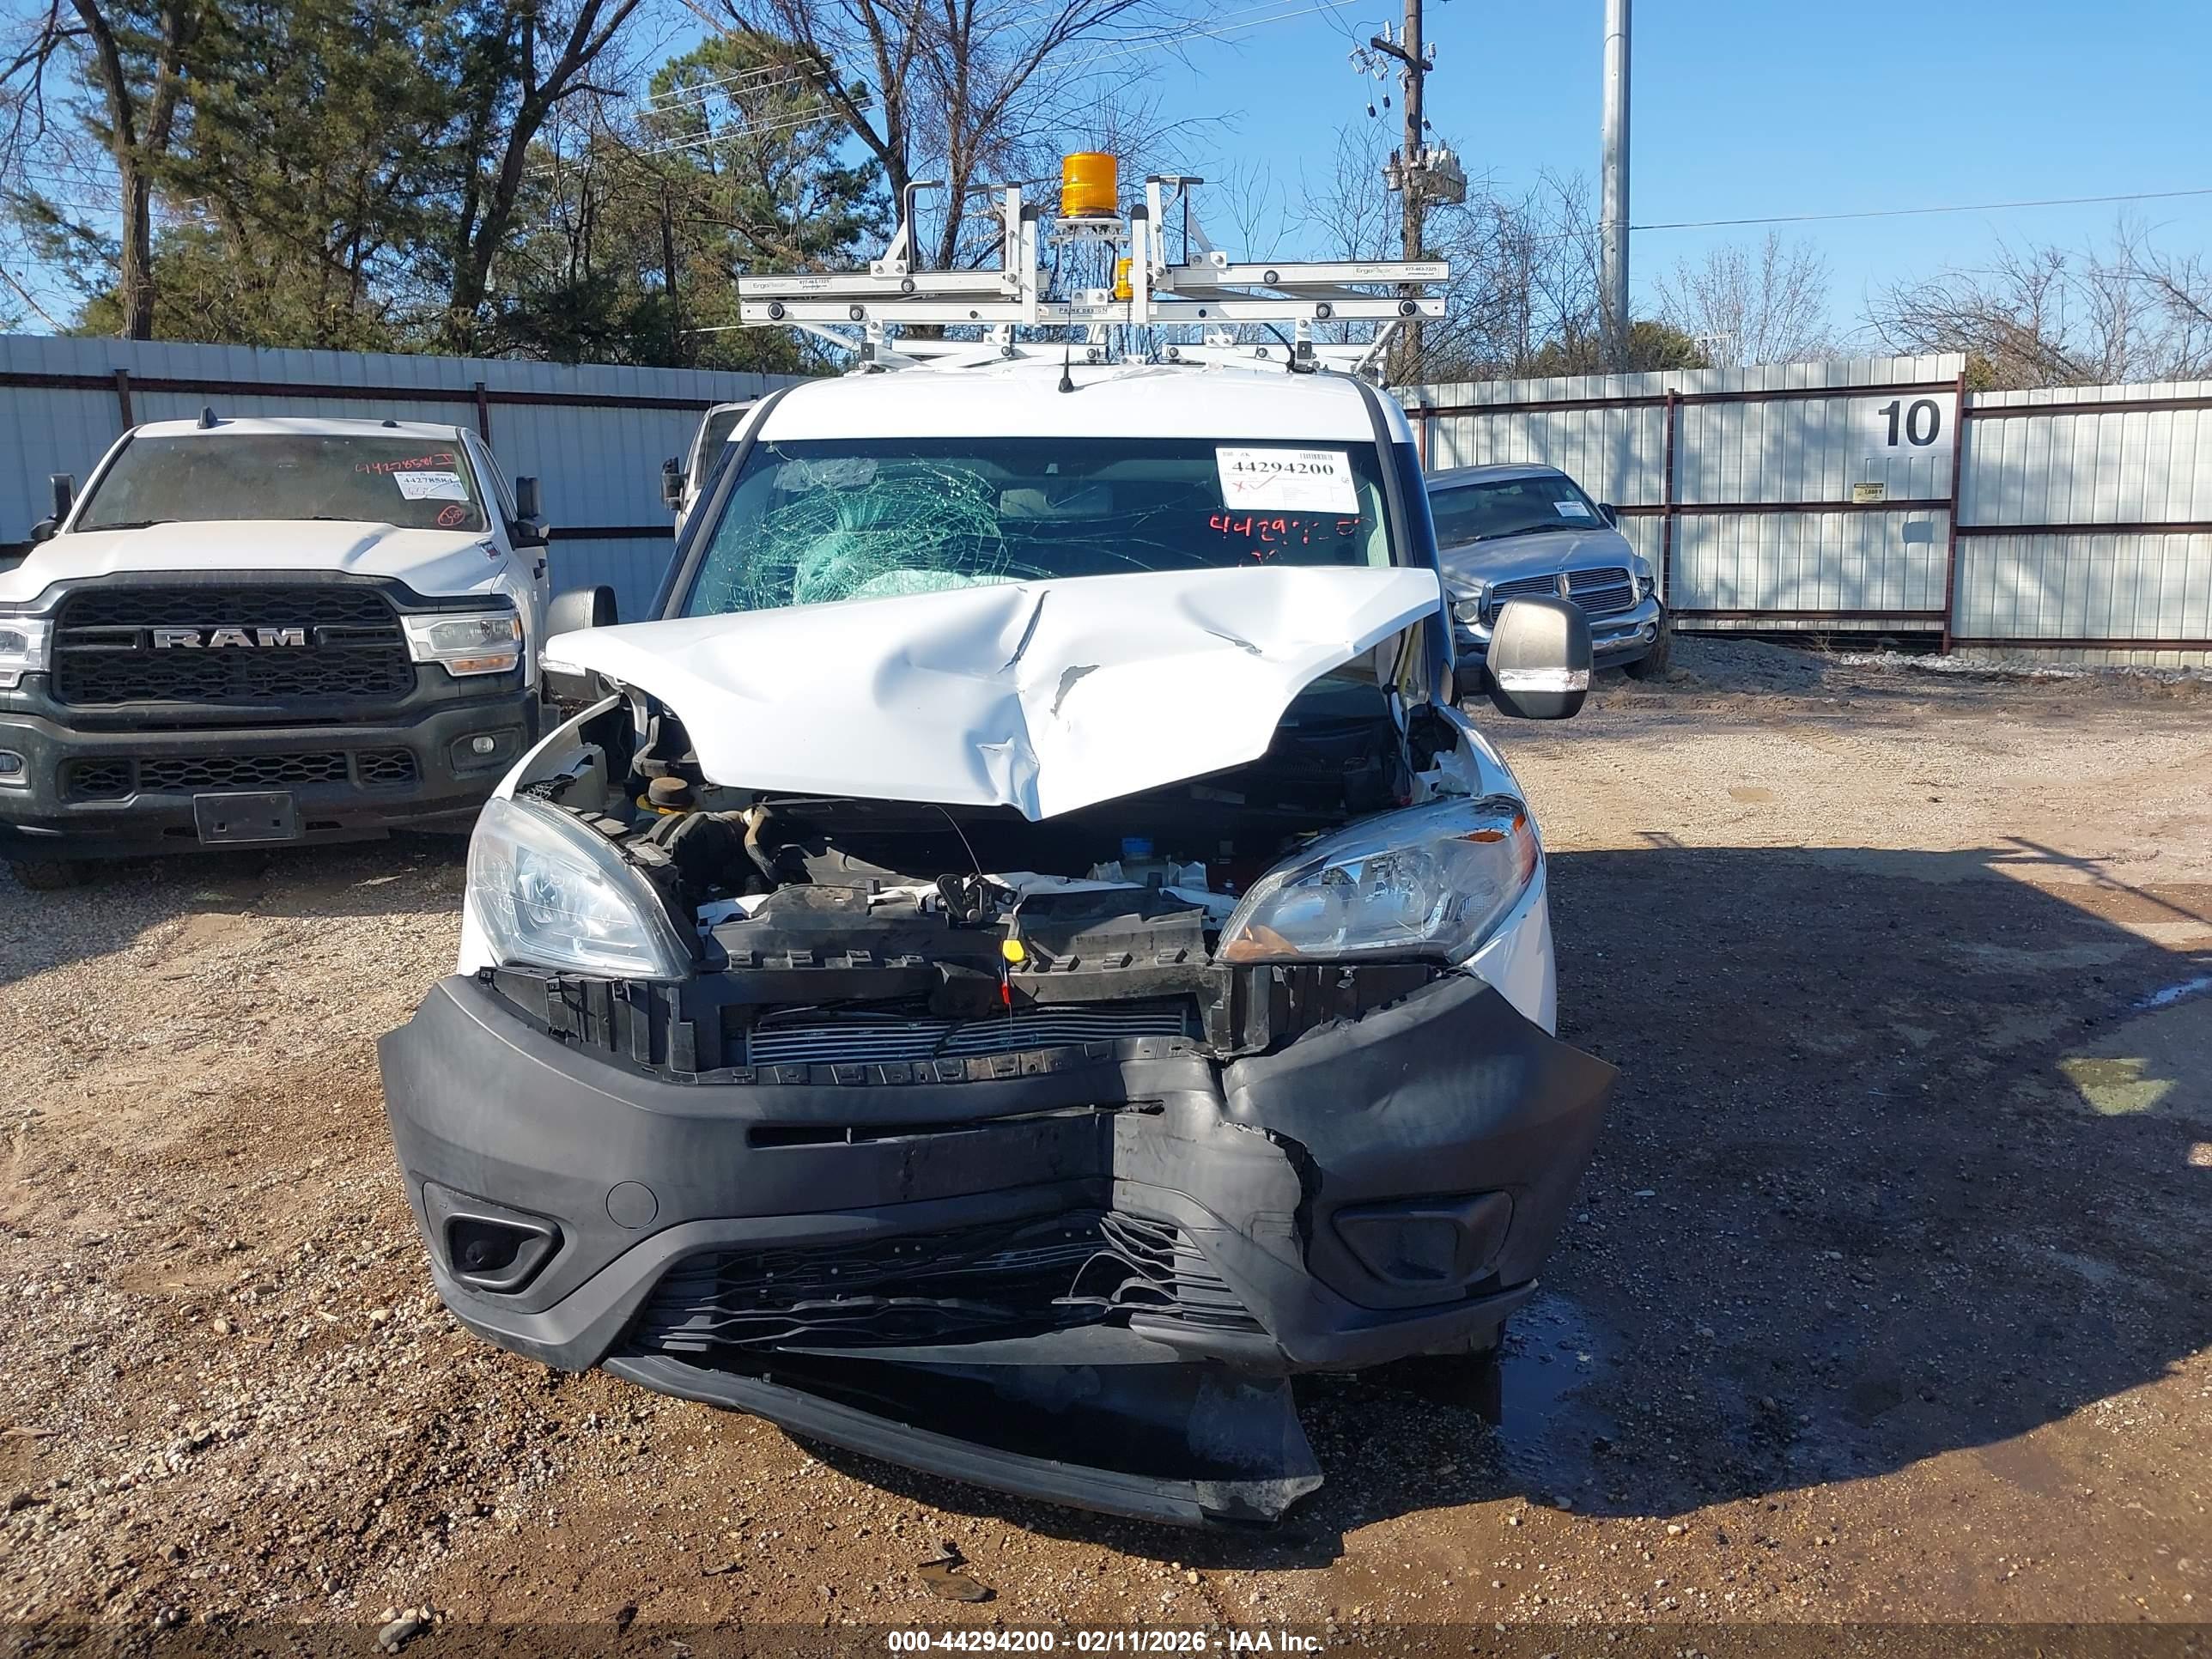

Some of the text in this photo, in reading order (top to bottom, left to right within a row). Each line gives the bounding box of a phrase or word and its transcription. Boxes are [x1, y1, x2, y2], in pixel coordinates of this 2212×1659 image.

[1878, 398, 1941, 447] 10
[1231, 461, 1334, 476] 44294200
[153, 628, 306, 649] RAM
